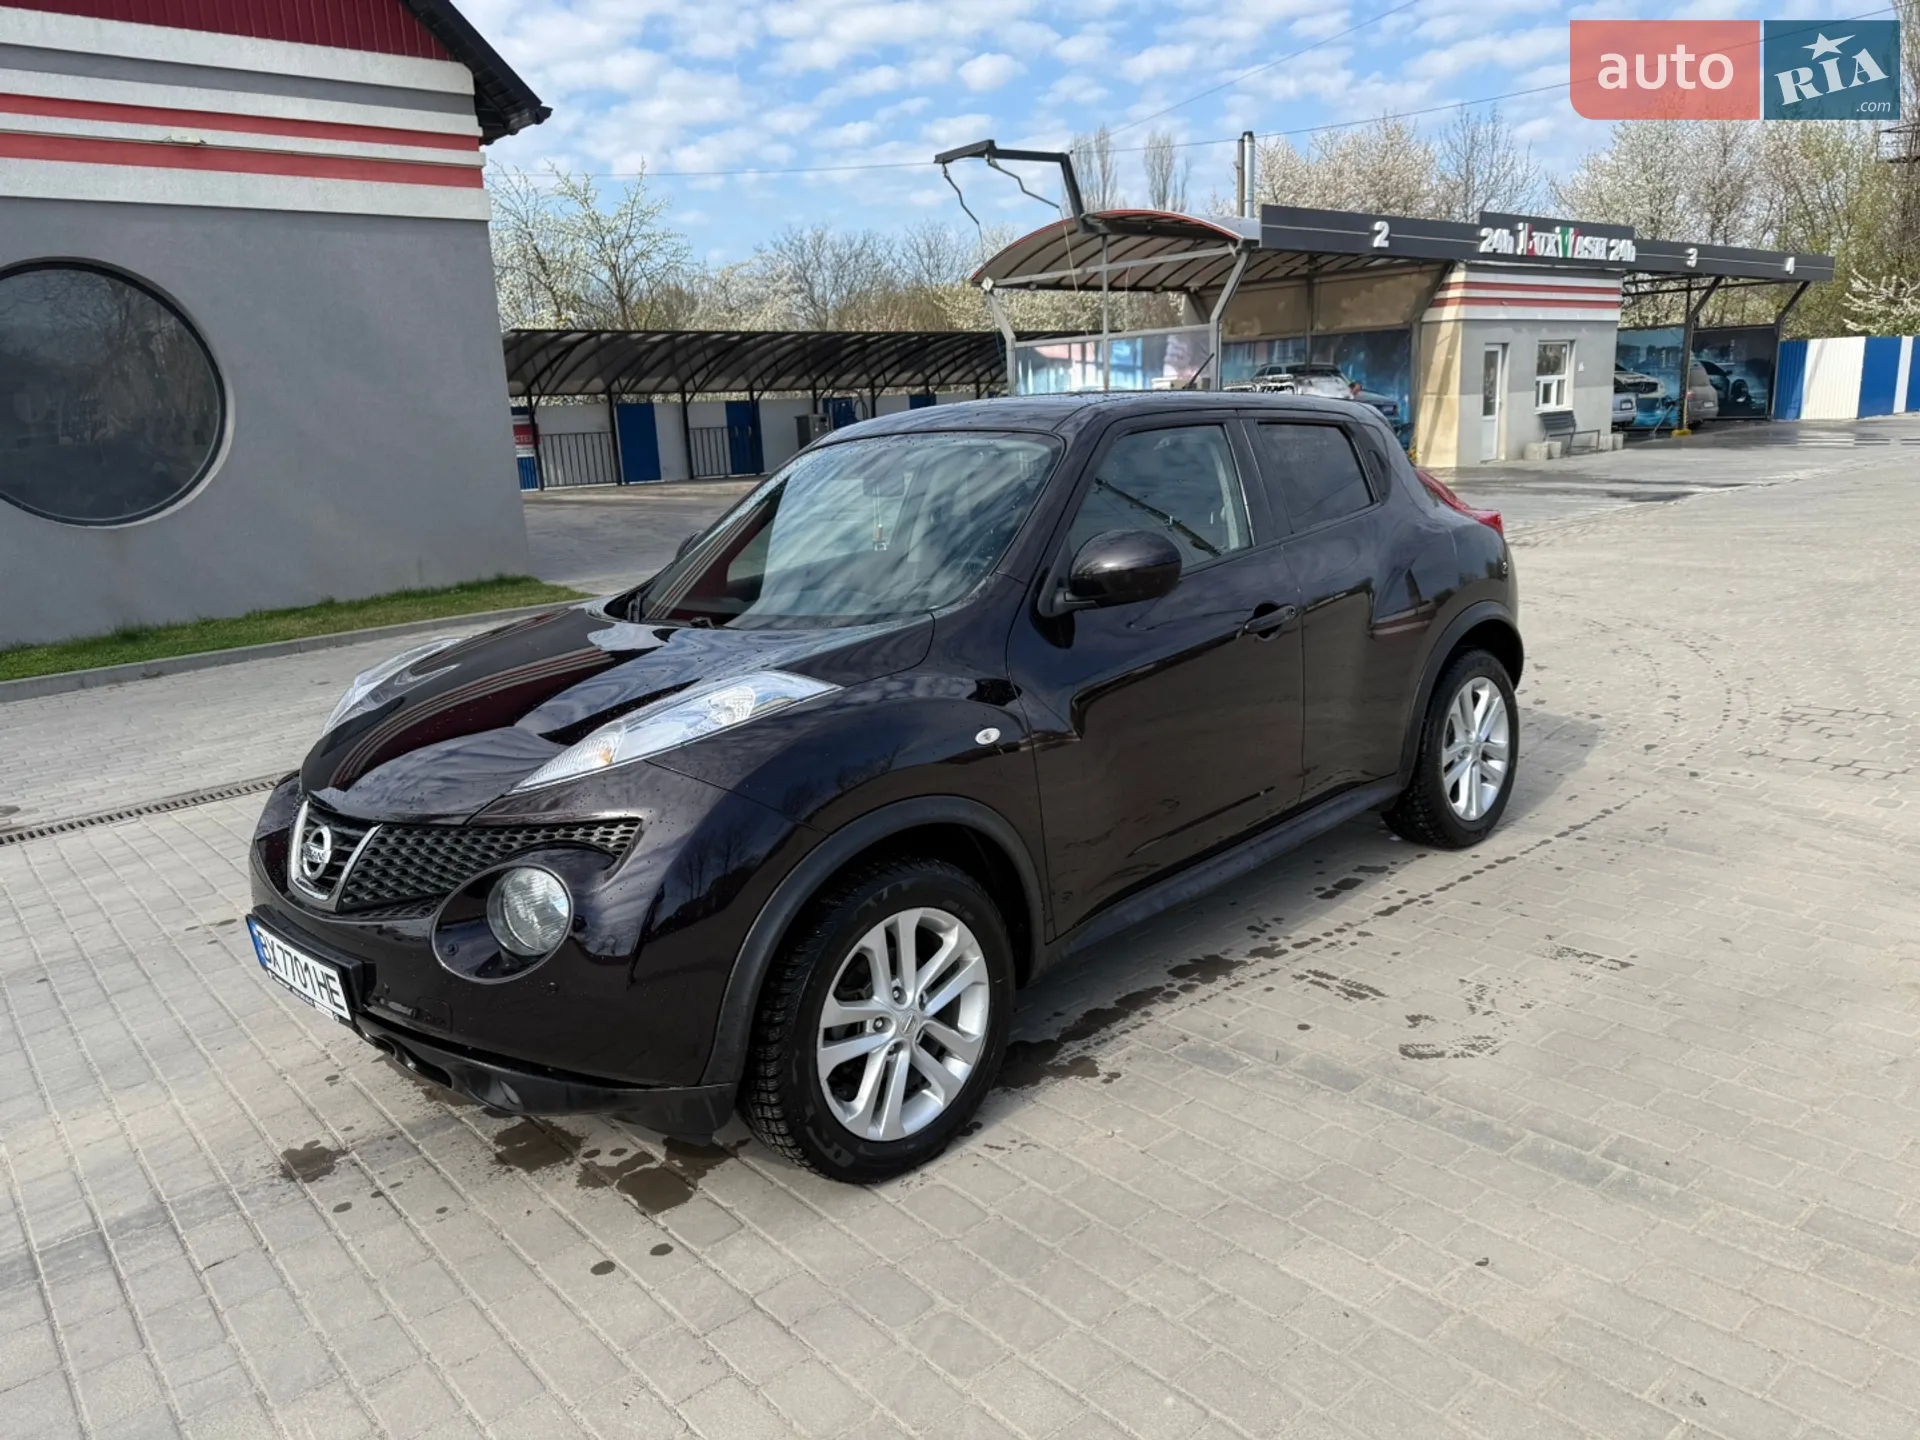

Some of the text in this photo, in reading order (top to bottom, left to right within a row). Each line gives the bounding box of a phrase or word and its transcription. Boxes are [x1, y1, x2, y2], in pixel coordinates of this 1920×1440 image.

[1373, 221, 1390, 248] 2
[1479, 227, 1514, 254] 24h
[1608, 238, 1636, 262] 24h
[1685, 247, 1698, 268] 3
[1785, 256, 1796, 275] 4
